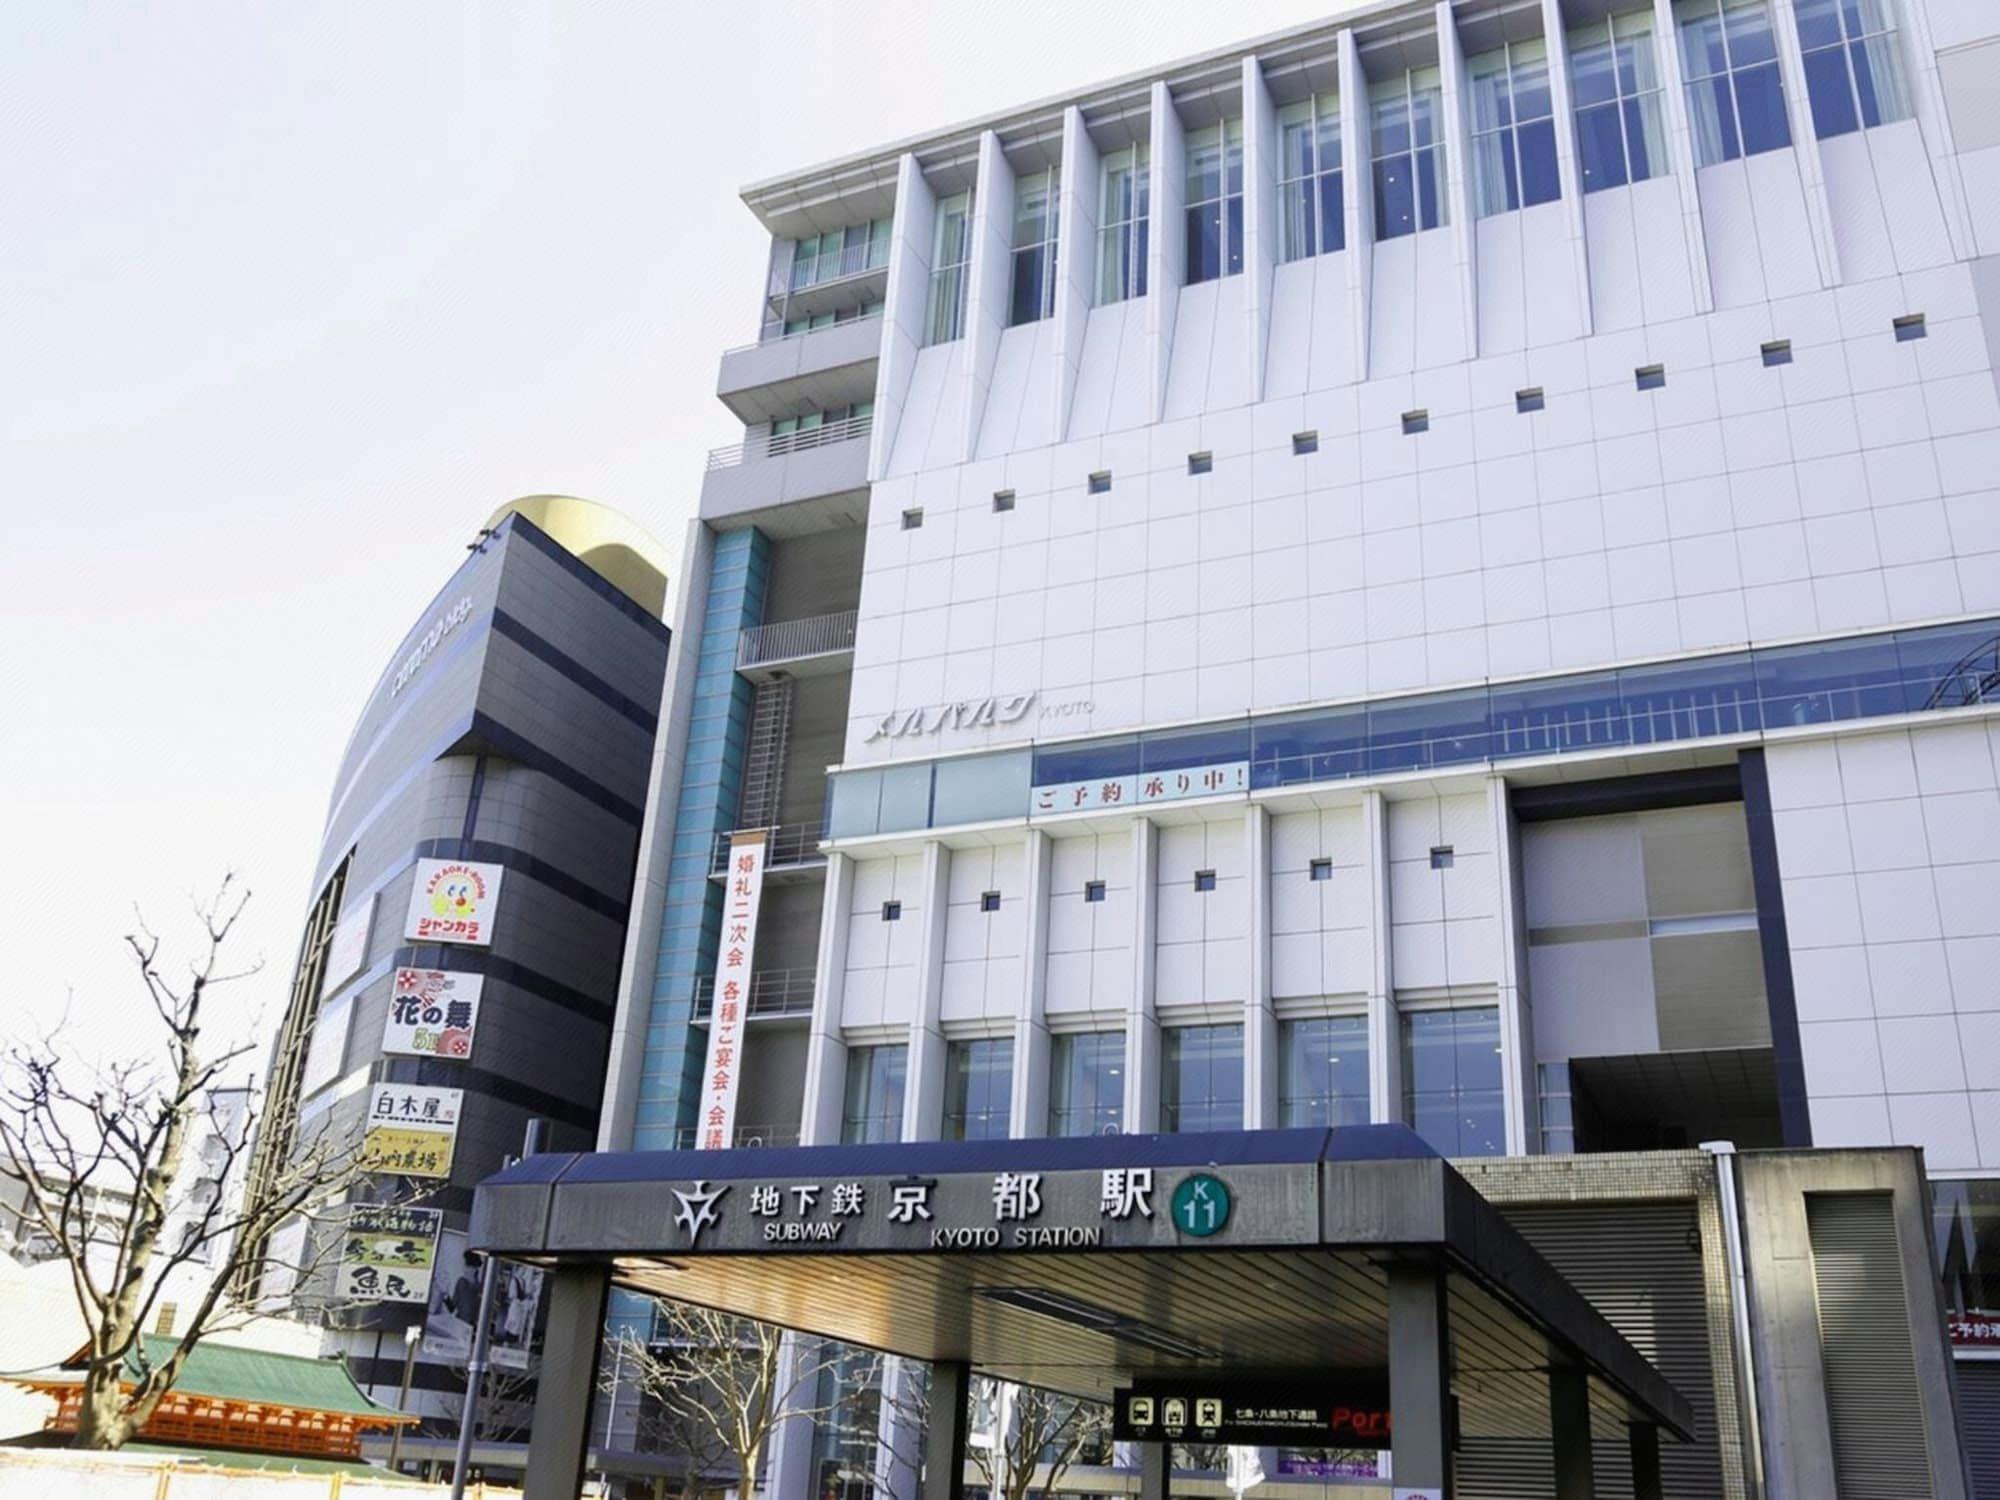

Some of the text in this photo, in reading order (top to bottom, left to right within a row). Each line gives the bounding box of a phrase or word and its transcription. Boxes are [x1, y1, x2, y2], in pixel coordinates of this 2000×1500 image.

[864, 690, 1037, 743] メルパルク
[1040, 701, 1096, 720] KYOTO
[1038, 783, 1122, 809] ご予約
[726, 854, 754, 967] 婚礼二次会
[419, 918, 479, 934] ジャンカラ
[394, 995, 471, 1029] 花の舞
[377, 1091, 440, 1118] 白木屋
[750, 1168, 1151, 1222] 地下鉄 京都駅
[1193, 1182, 1209, 1199] K
[1183, 1200, 1216, 1229] 11
[763, 1222, 1100, 1247] SUBWAY KYOTO STATION
[349, 1266, 411, 1298] 魚民
